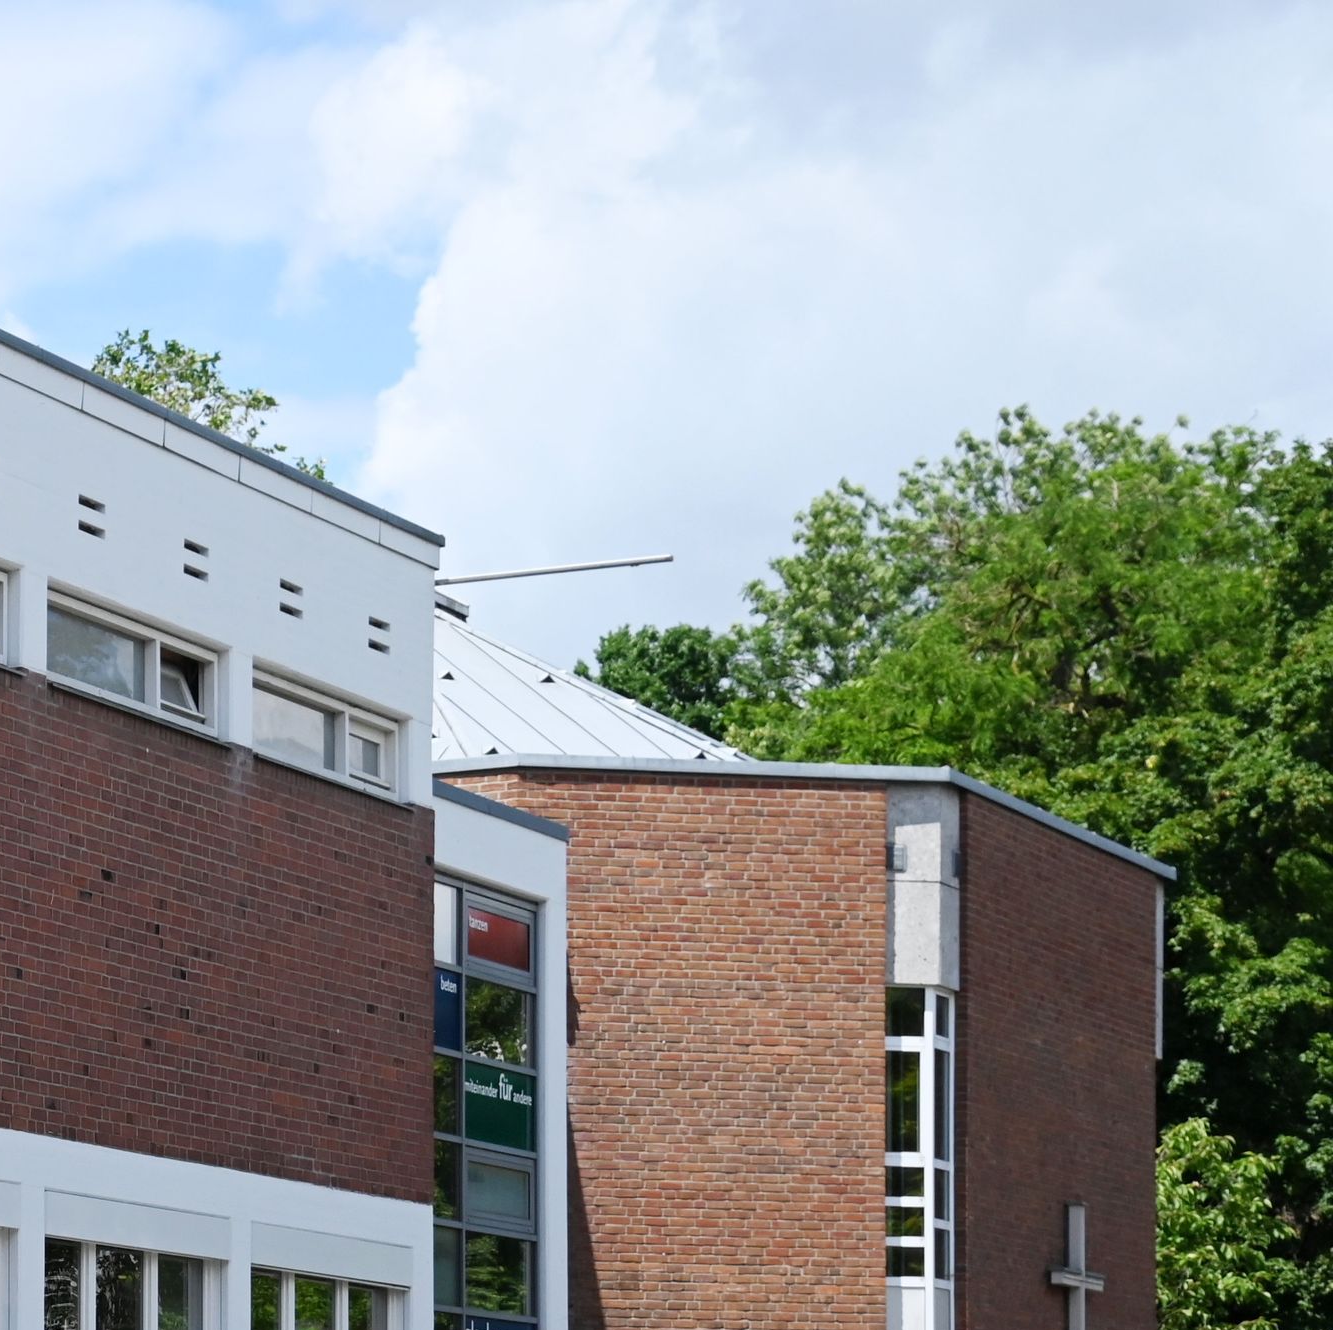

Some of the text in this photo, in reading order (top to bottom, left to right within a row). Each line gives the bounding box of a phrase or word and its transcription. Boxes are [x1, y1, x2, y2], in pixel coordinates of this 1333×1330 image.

[469, 915, 488, 932] tanzen
[440, 975, 457, 993] beten
[464, 1073, 532, 1106] miteinander für andere
